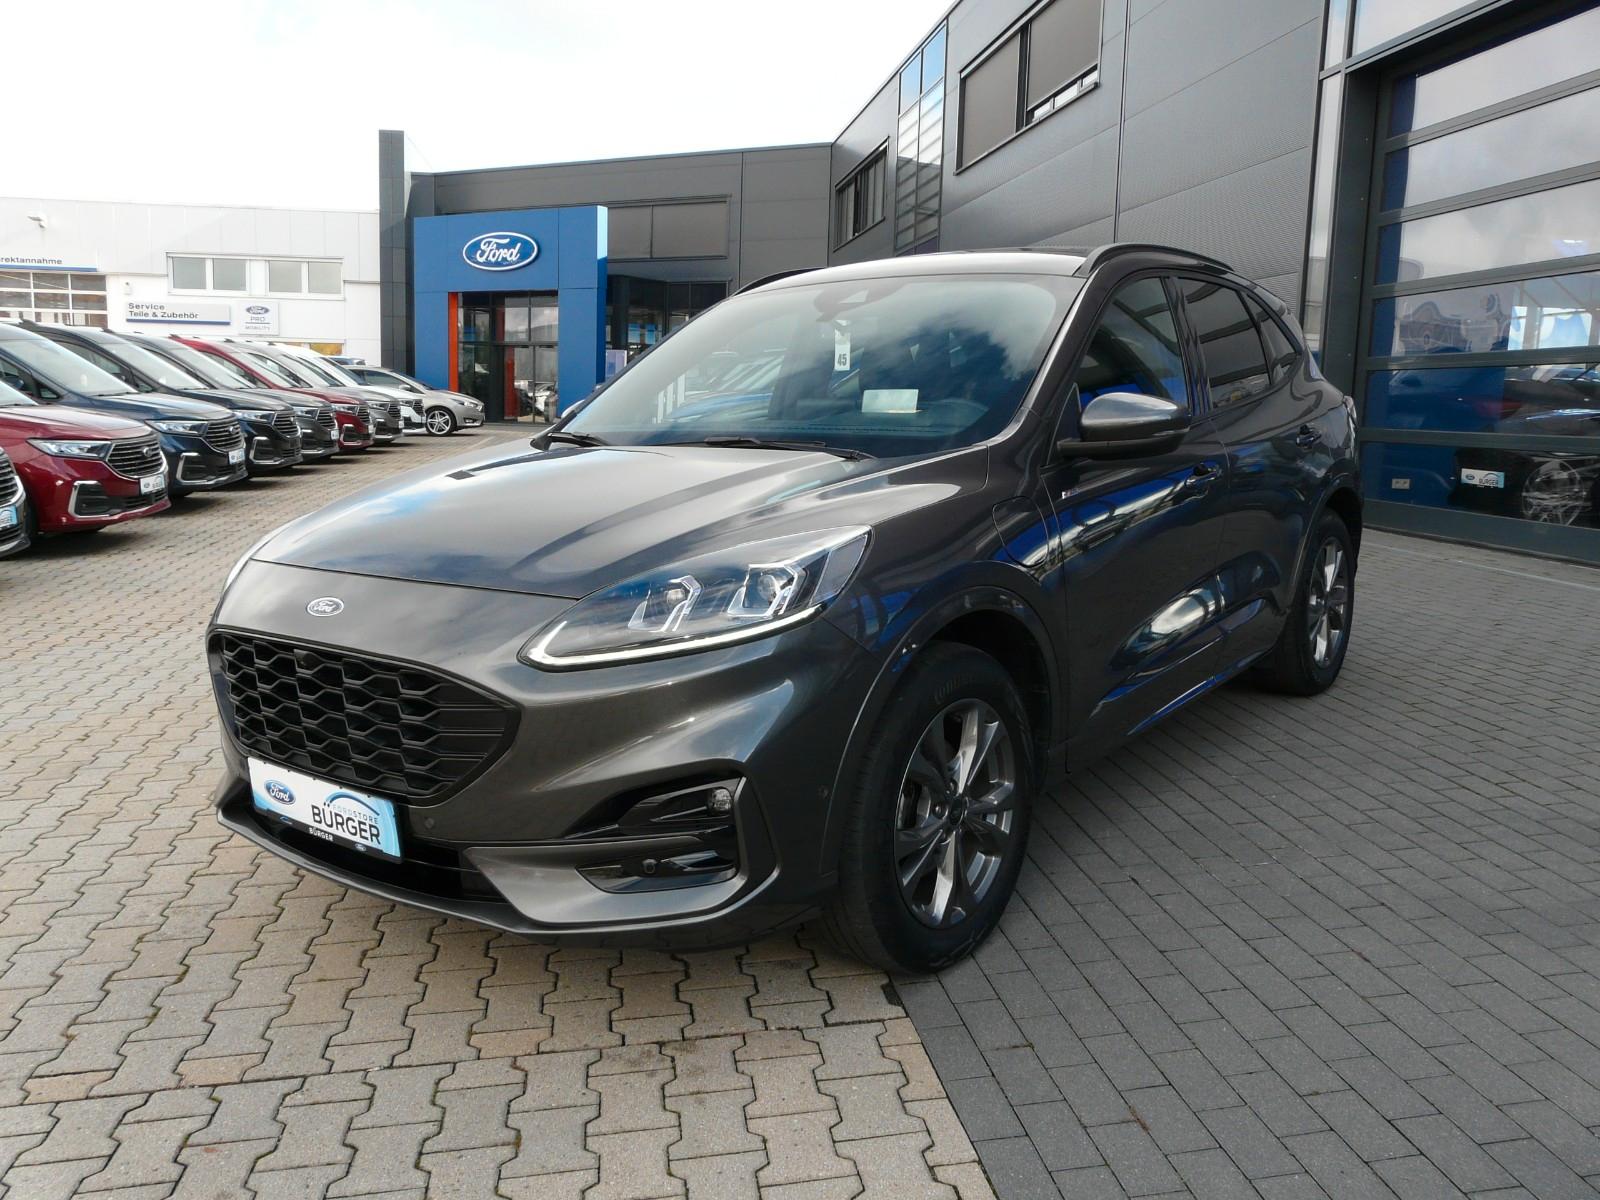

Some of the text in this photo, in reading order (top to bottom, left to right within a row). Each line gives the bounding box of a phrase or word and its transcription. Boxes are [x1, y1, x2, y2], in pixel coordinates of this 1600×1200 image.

[476, 238, 521, 263] Ford
[837, 354, 848, 366] 45
[311, 801, 381, 845] BÜRGER
[308, 827, 334, 841] BÜRGER
